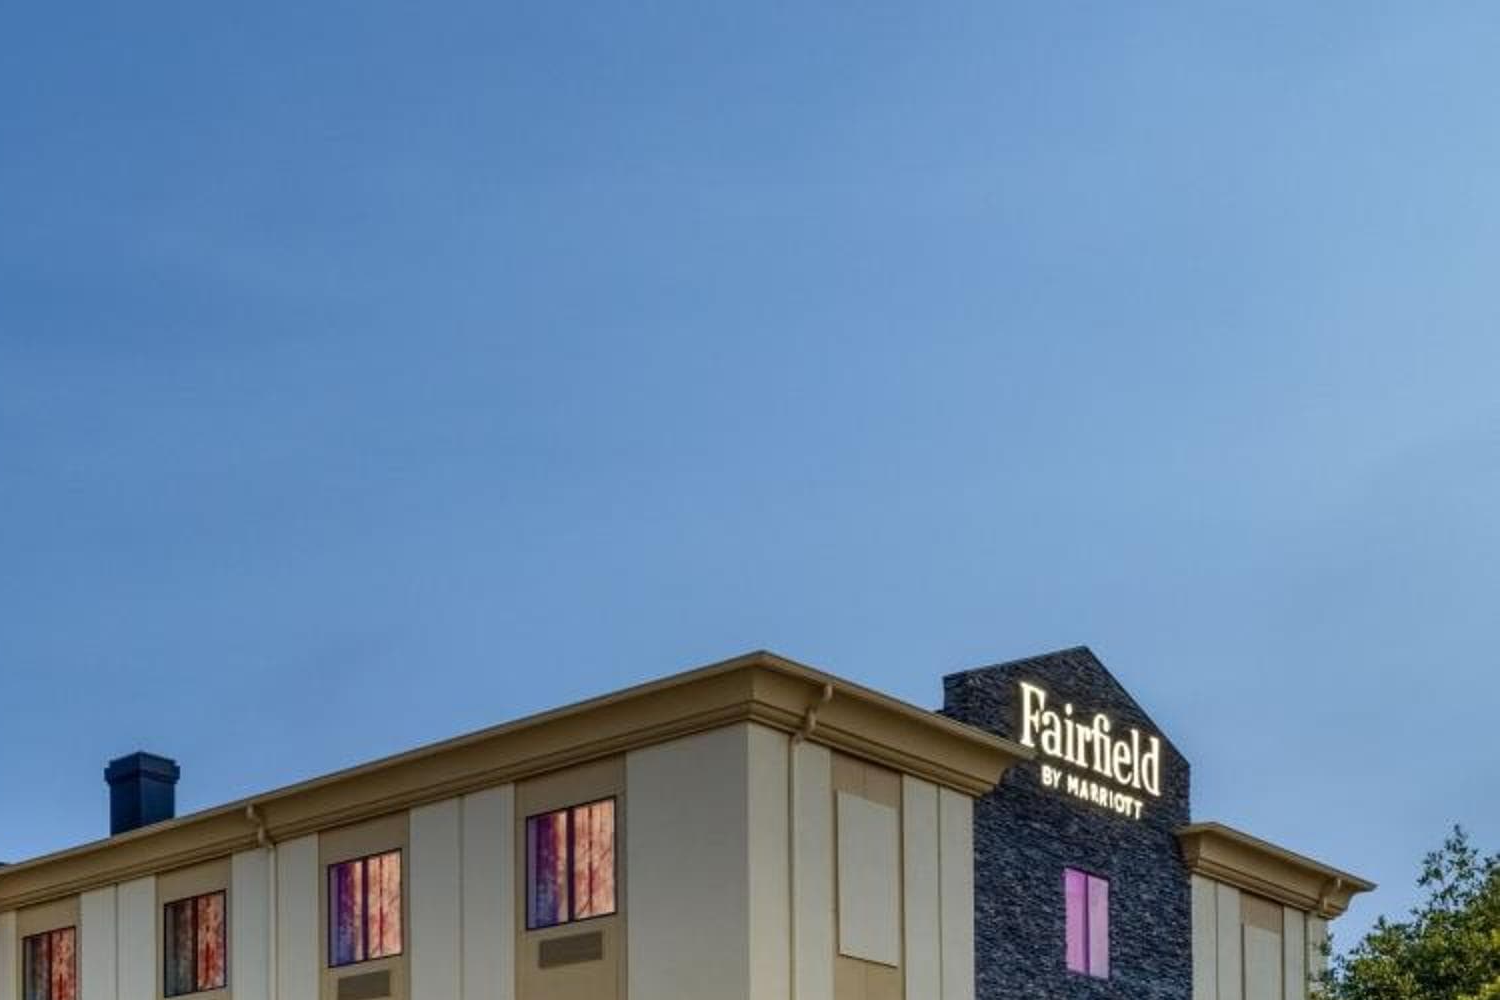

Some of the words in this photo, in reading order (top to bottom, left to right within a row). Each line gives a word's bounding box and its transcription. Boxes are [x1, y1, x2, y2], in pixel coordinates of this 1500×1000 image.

[1020, 682, 1160, 797] Fairfield
[1041, 765, 1060, 788] BY
[1067, 775, 1143, 820] MARRIOTT
